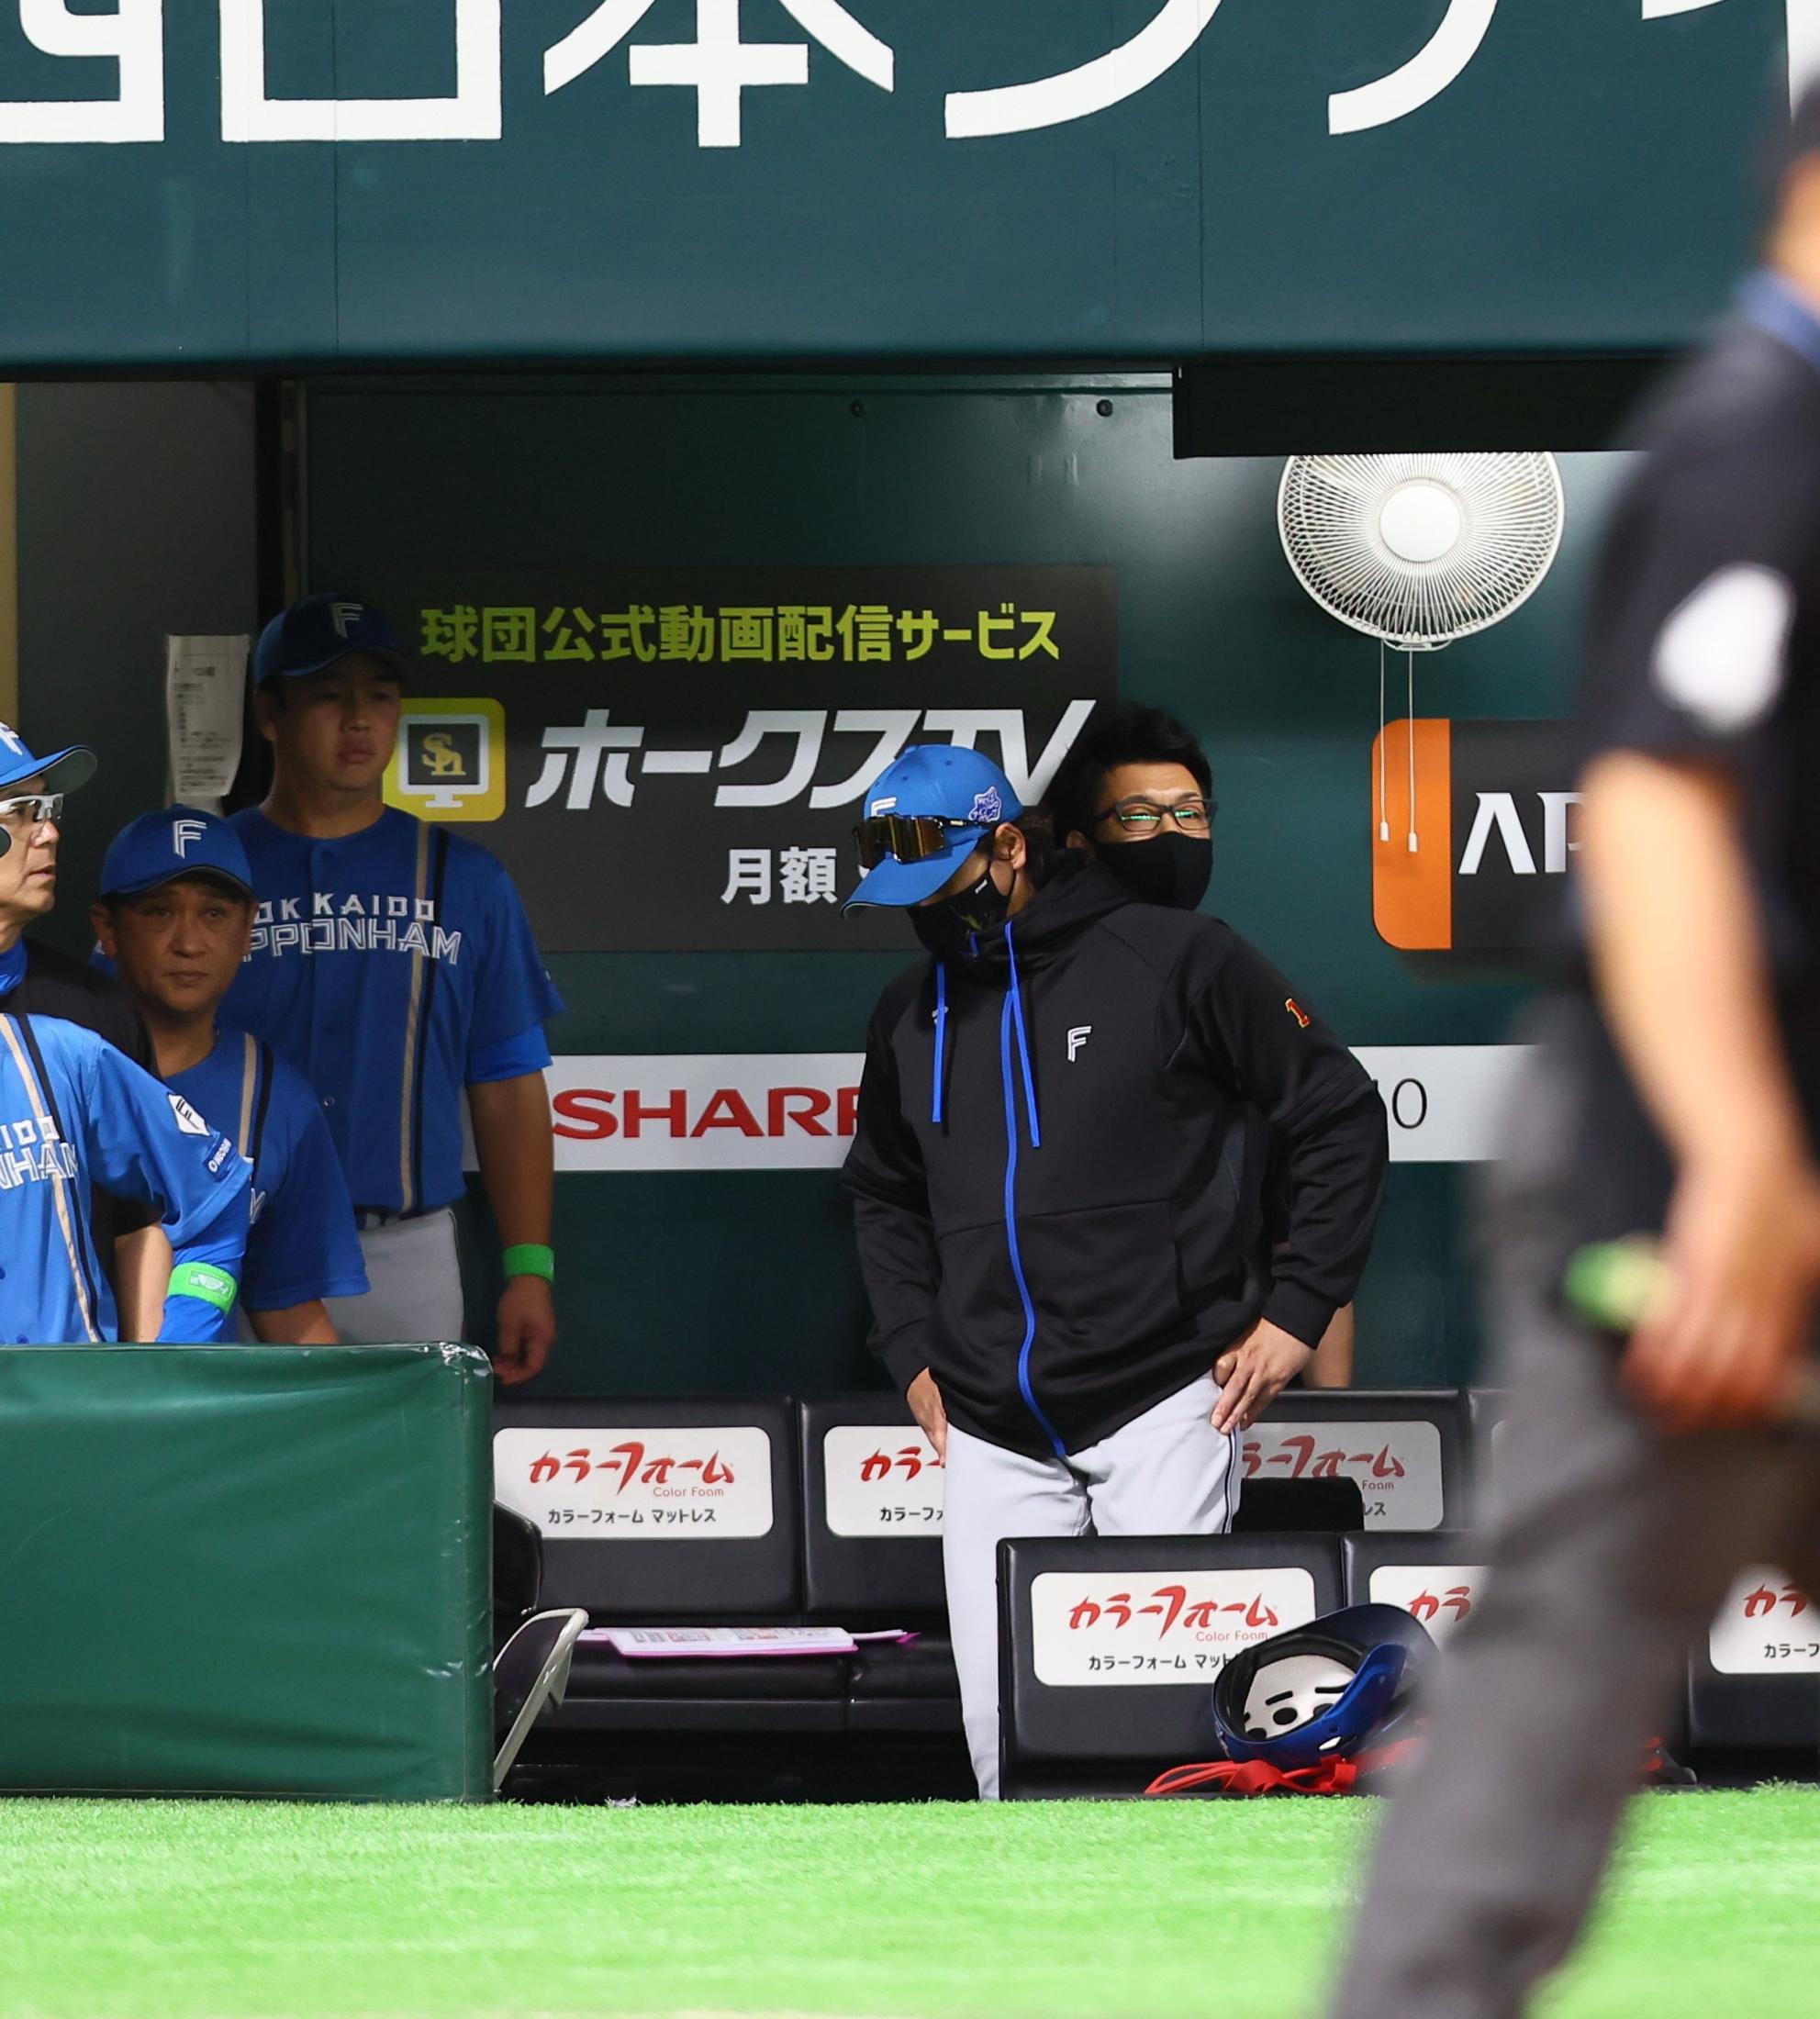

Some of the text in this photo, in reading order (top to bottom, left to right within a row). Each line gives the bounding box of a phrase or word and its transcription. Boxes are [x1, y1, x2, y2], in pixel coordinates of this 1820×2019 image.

[420, 604, 1059, 663] 球団公式動画配信サービス
[173, 819, 207, 858] F
[720, 846, 838, 905] 月額
[1067, 1025, 1092, 1063] F
[530, 1441, 734, 1497] カラーフォーム
[1362, 1479, 1394, 1491] Foam
[653, 1487, 724, 1498] Color Foam
[549, 1508, 716, 1524] カラーフォーム マットレス
[1068, 1585, 1278, 1641] カラーフォーム
[1196, 1630, 1268, 1643] Color Foam
[1089, 1655, 1187, 1670] カラーフォーム
